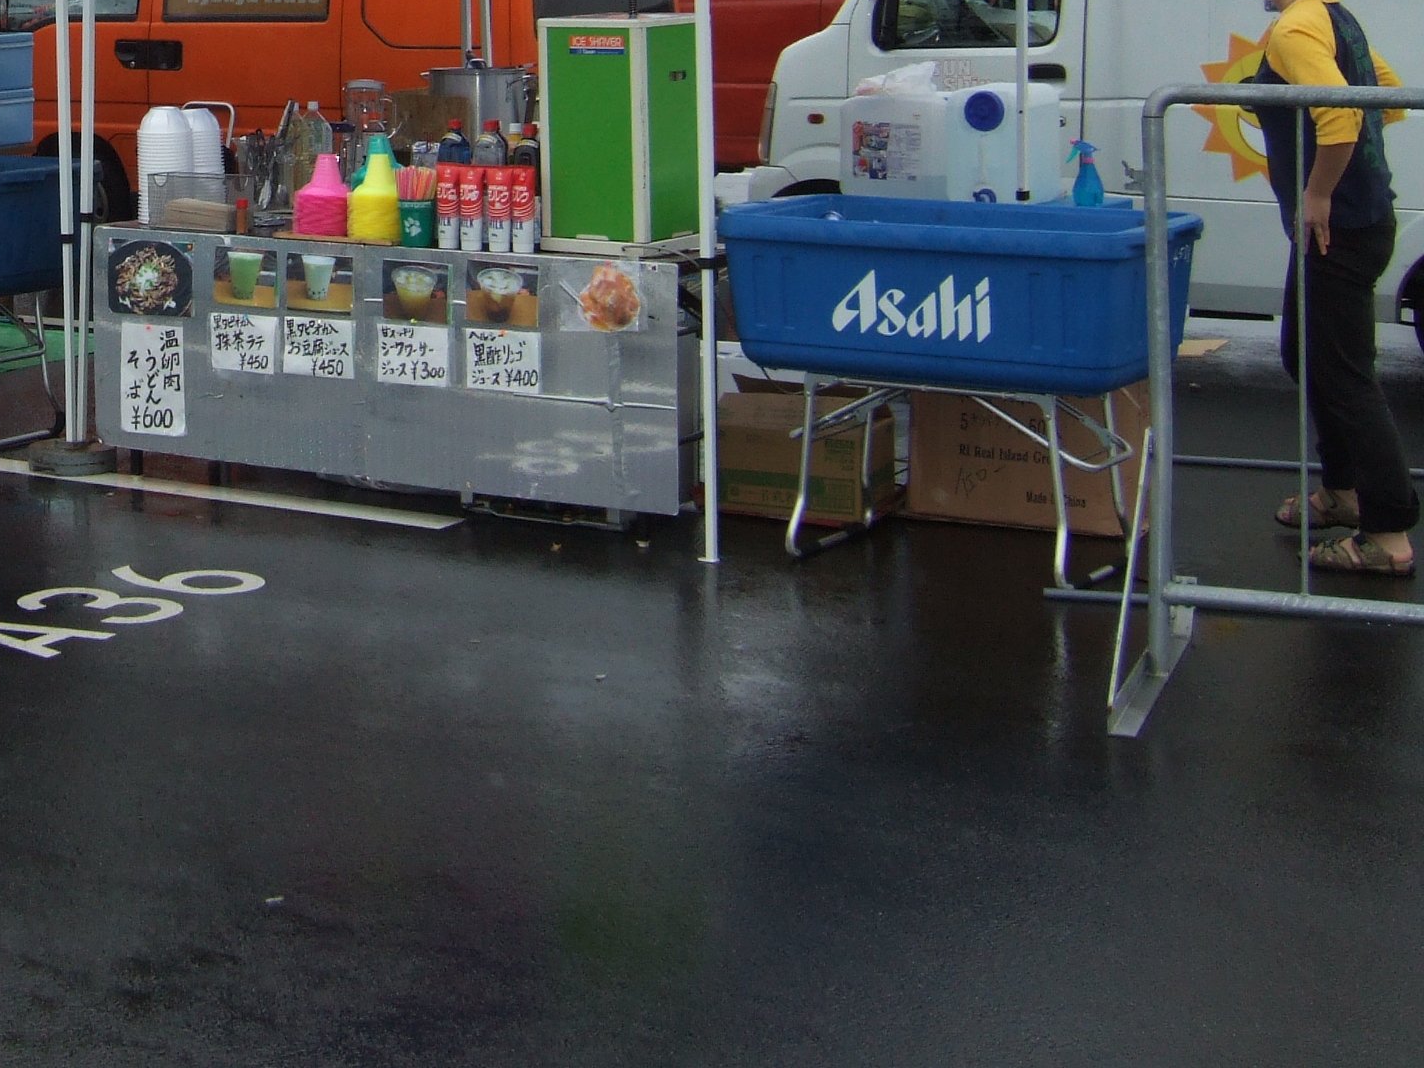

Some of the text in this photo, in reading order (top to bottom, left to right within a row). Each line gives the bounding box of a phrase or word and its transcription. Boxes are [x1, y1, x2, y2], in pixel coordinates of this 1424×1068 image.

[831, 269, 992, 343] Asahi
[311, 359, 344, 377] ¥450
[504, 368, 538, 387] ¥400
[131, 405, 174, 430] ¥600
